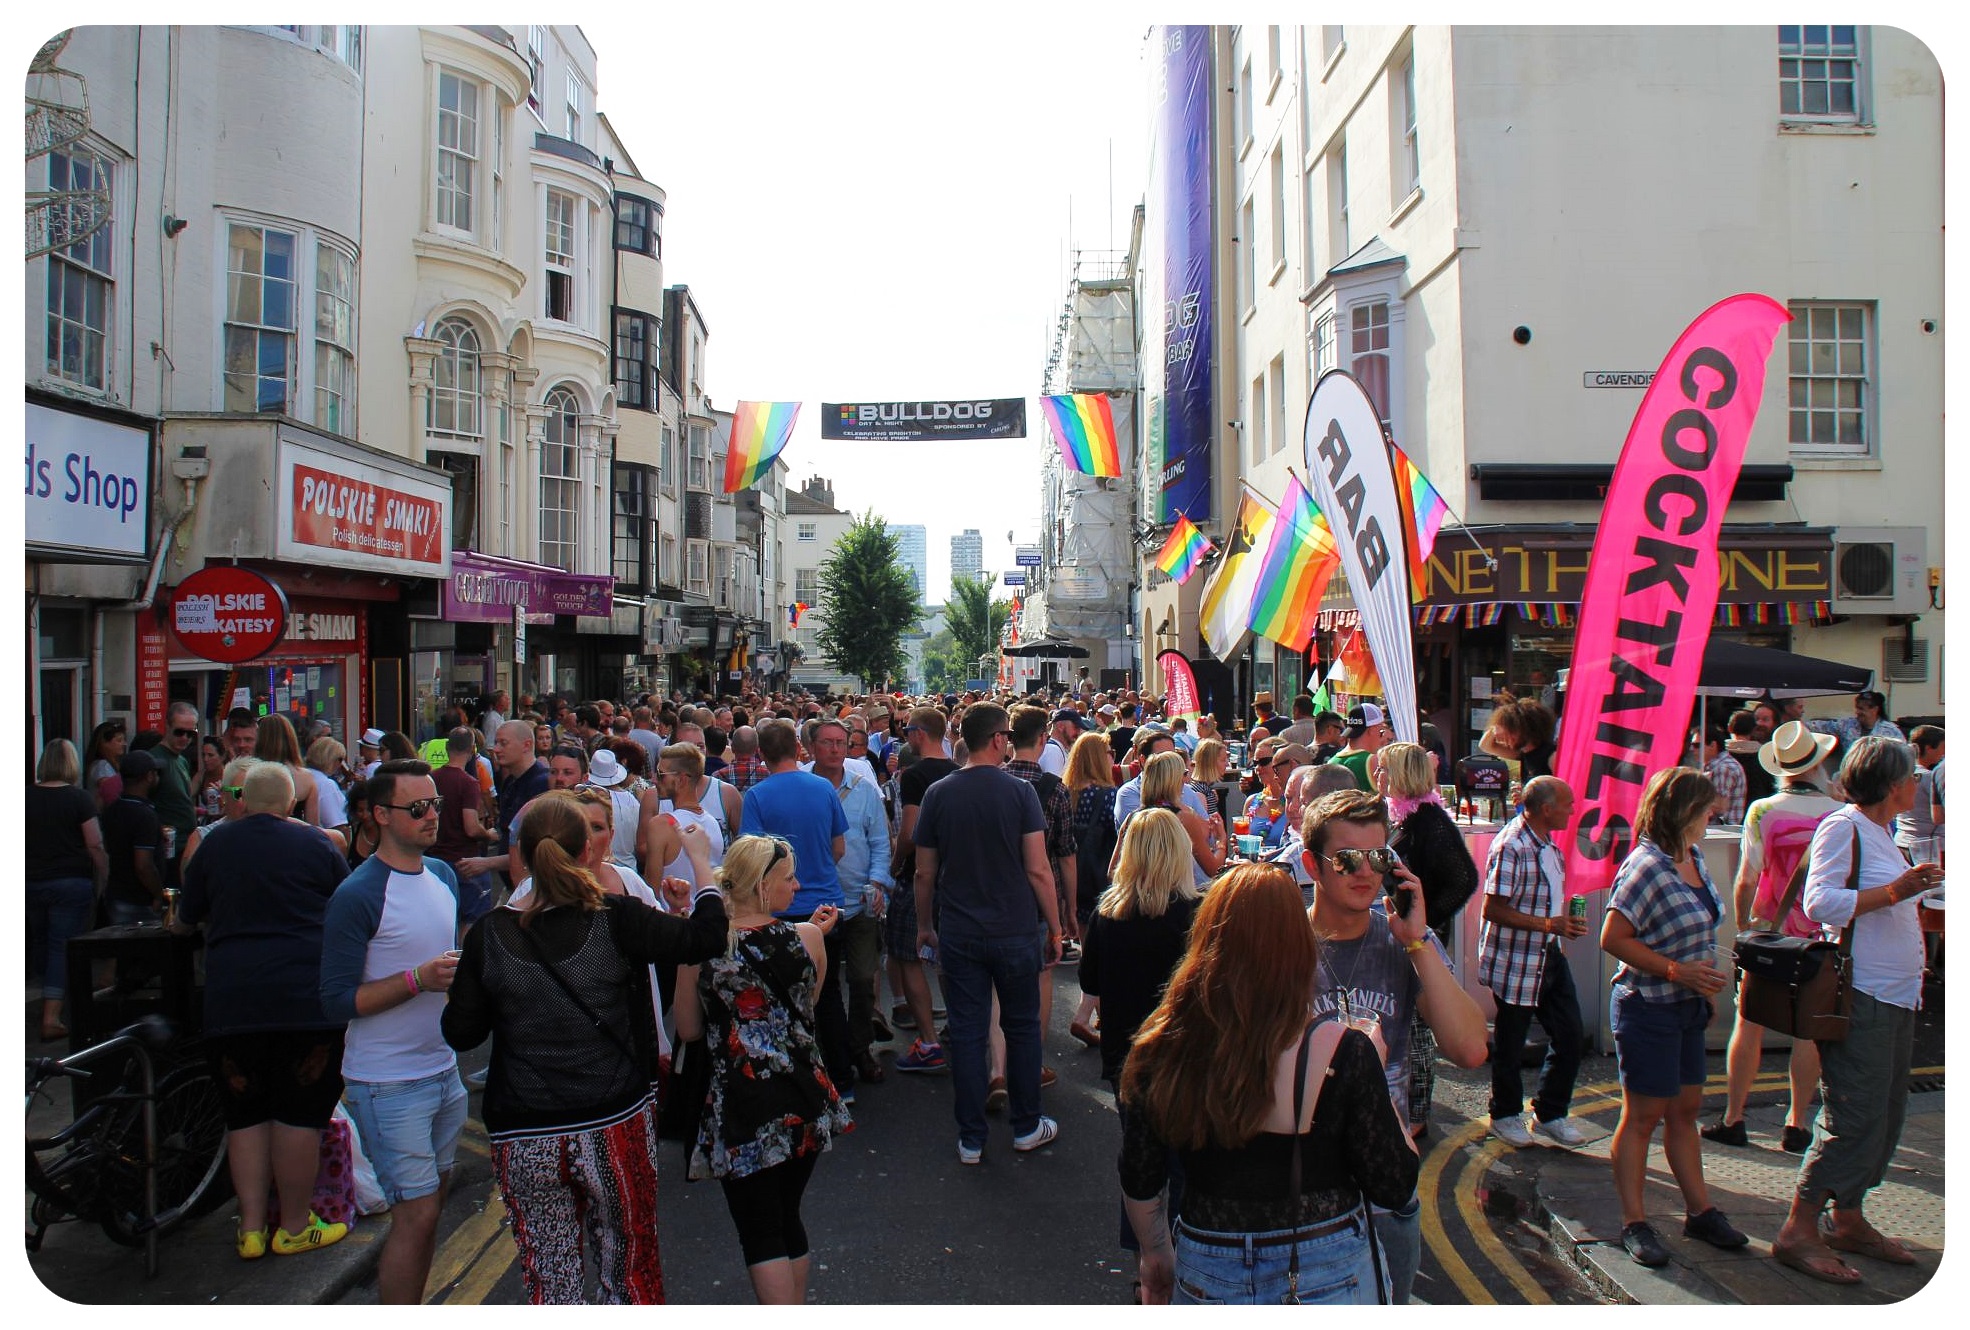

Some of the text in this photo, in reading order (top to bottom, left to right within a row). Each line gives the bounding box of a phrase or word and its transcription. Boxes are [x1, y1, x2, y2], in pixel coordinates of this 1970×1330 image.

[1168, 340, 1192, 363] BAR
[859, 402, 993, 420] BULLDOG
[65, 453, 138, 523] Shop
[302, 476, 376, 526] POLSKIE
[384, 499, 431, 537] SMAKI
[332, 527, 404, 552] Polish delicatessen
[1425, 547, 1493, 596] NE
[1718, 551, 1828, 590] NE
[454, 571, 530, 607] GOLDEN TOUCH
[553, 593, 587, 602] GOLDEN
[556, 602, 584, 610] TOUCH
[1576, 346, 1738, 867] COCKTAILS
[176, 616, 207, 625] BEERS
[180, 618, 275, 634] KATESY
[309, 613, 356, 640] SMAKI
